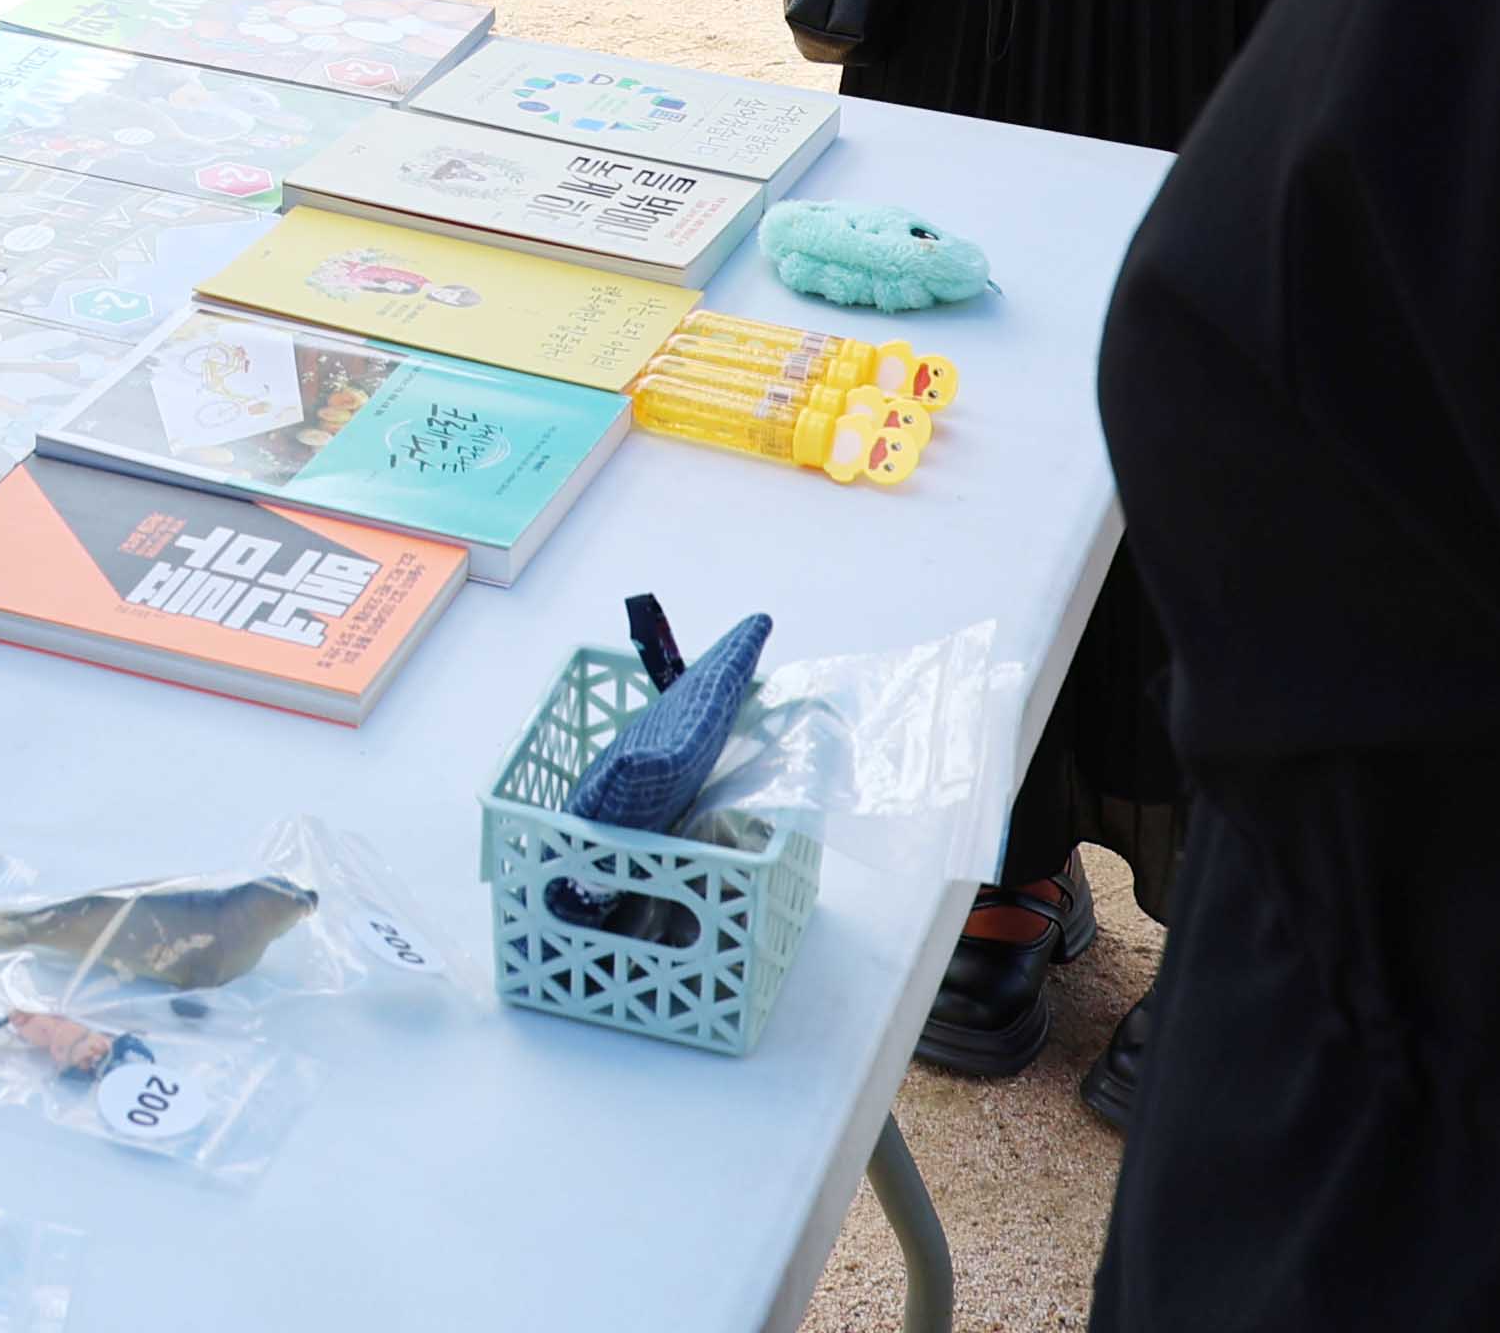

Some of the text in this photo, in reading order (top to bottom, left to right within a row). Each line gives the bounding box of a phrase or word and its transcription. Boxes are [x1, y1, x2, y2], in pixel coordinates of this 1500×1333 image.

[557, 156, 633, 200] 놀게
[631, 169, 698, 195] 틀
[387, 403, 480, 475] 크레파스
[124, 525, 281, 628] 무릎
[218, 550, 383, 648] 백년
[368, 919, 426, 965] 200
[126, 1076, 180, 1128] 200
